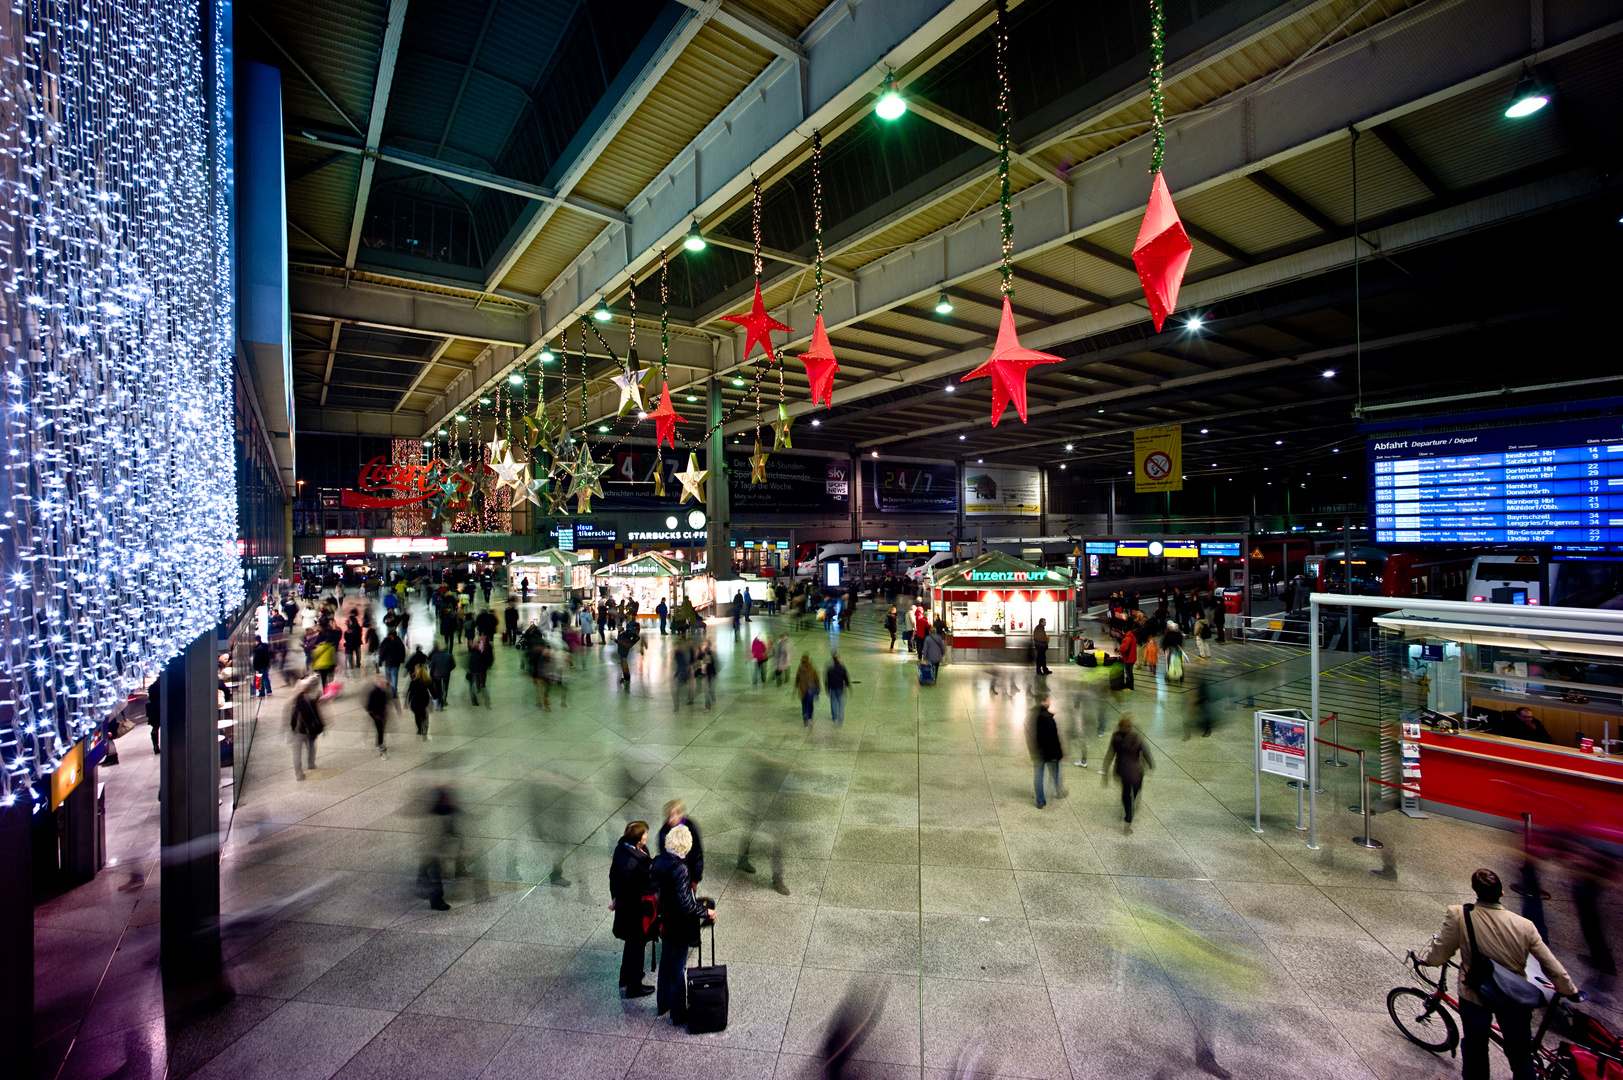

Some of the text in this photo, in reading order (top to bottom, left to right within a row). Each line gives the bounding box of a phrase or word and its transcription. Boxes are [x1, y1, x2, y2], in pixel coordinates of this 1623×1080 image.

[1374, 441, 1408, 450] Abfahrt
[1411, 439, 1447, 447] Departure
[733, 459, 746, 467] Der
[827, 467, 846, 480] sky
[741, 482, 755, 491] Tage
[885, 470, 933, 493] 24/7
[628, 532, 681, 540] STARBUCKS
[962, 569, 1047, 581] vinzenzmurr
